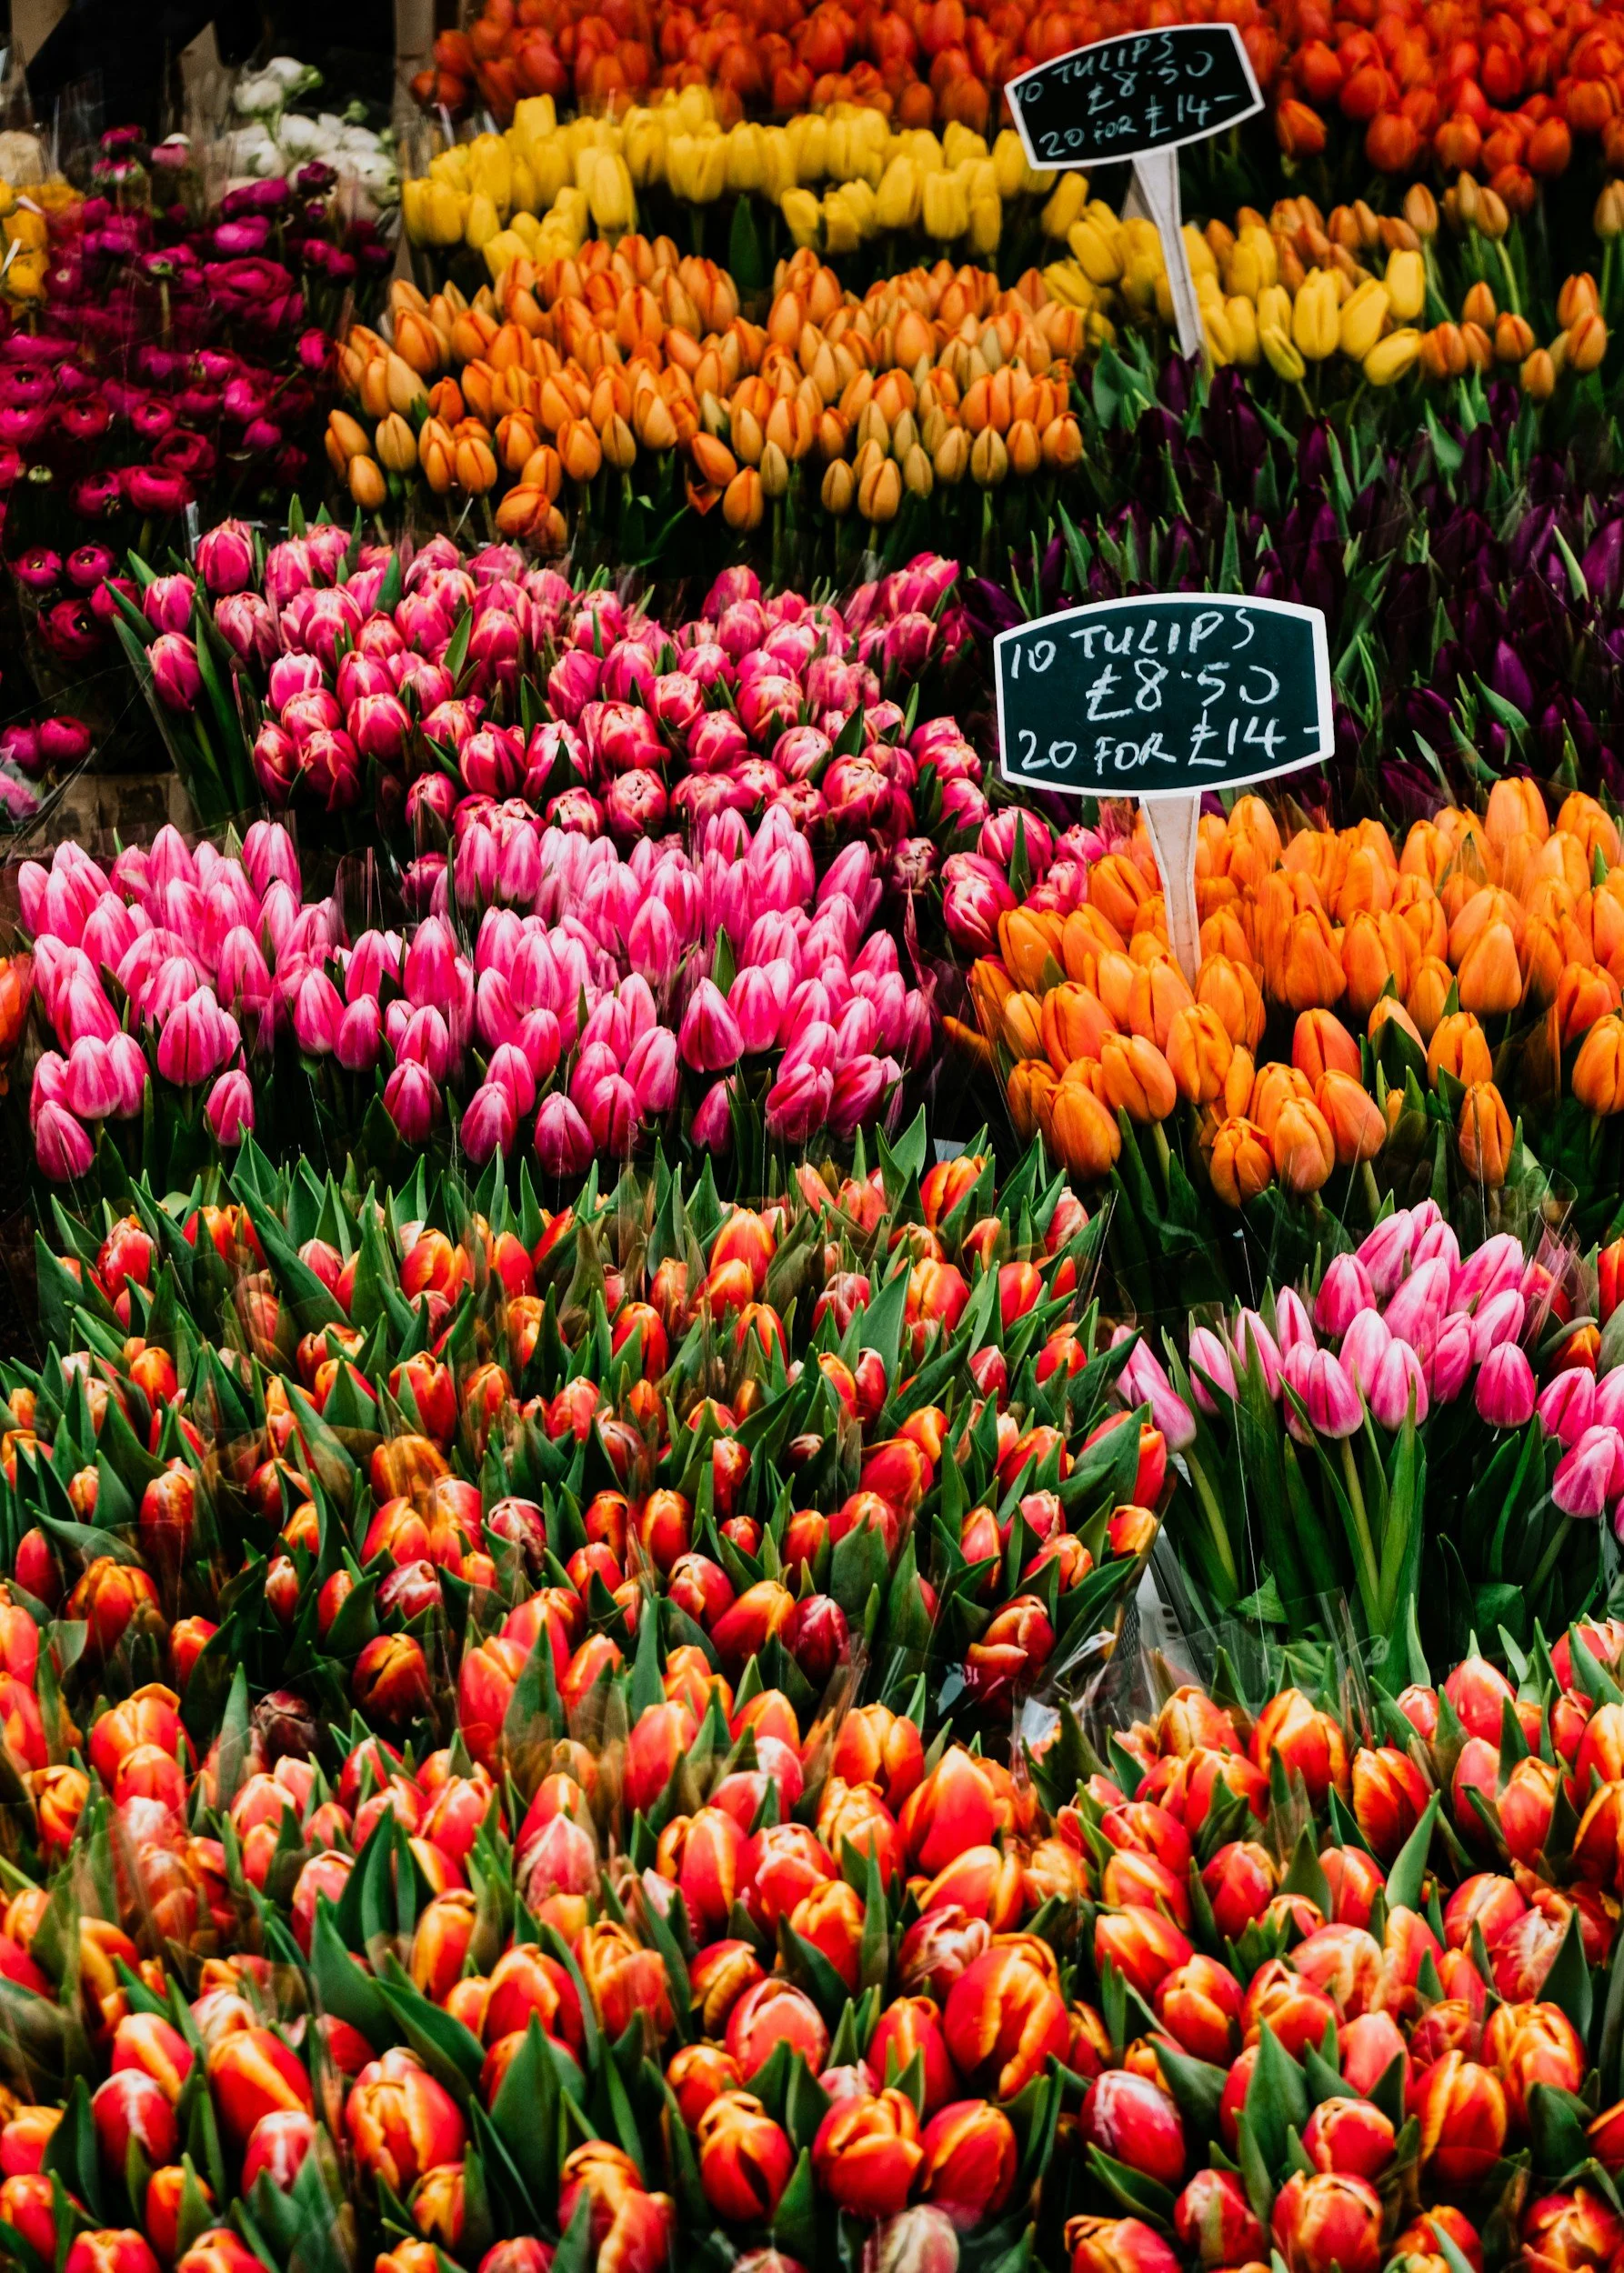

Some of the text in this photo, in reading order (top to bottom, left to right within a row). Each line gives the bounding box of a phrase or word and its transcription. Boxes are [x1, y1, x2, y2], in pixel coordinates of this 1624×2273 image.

[1016, 32, 1174, 103] 10 TULIPS
[1039, 128, 1085, 156] 20
[1093, 115, 1137, 145] FOR
[1011, 608, 1255, 679] 10 TULIPS
[1018, 729, 1077, 770] 20
[1094, 733, 1177, 776] FOR
